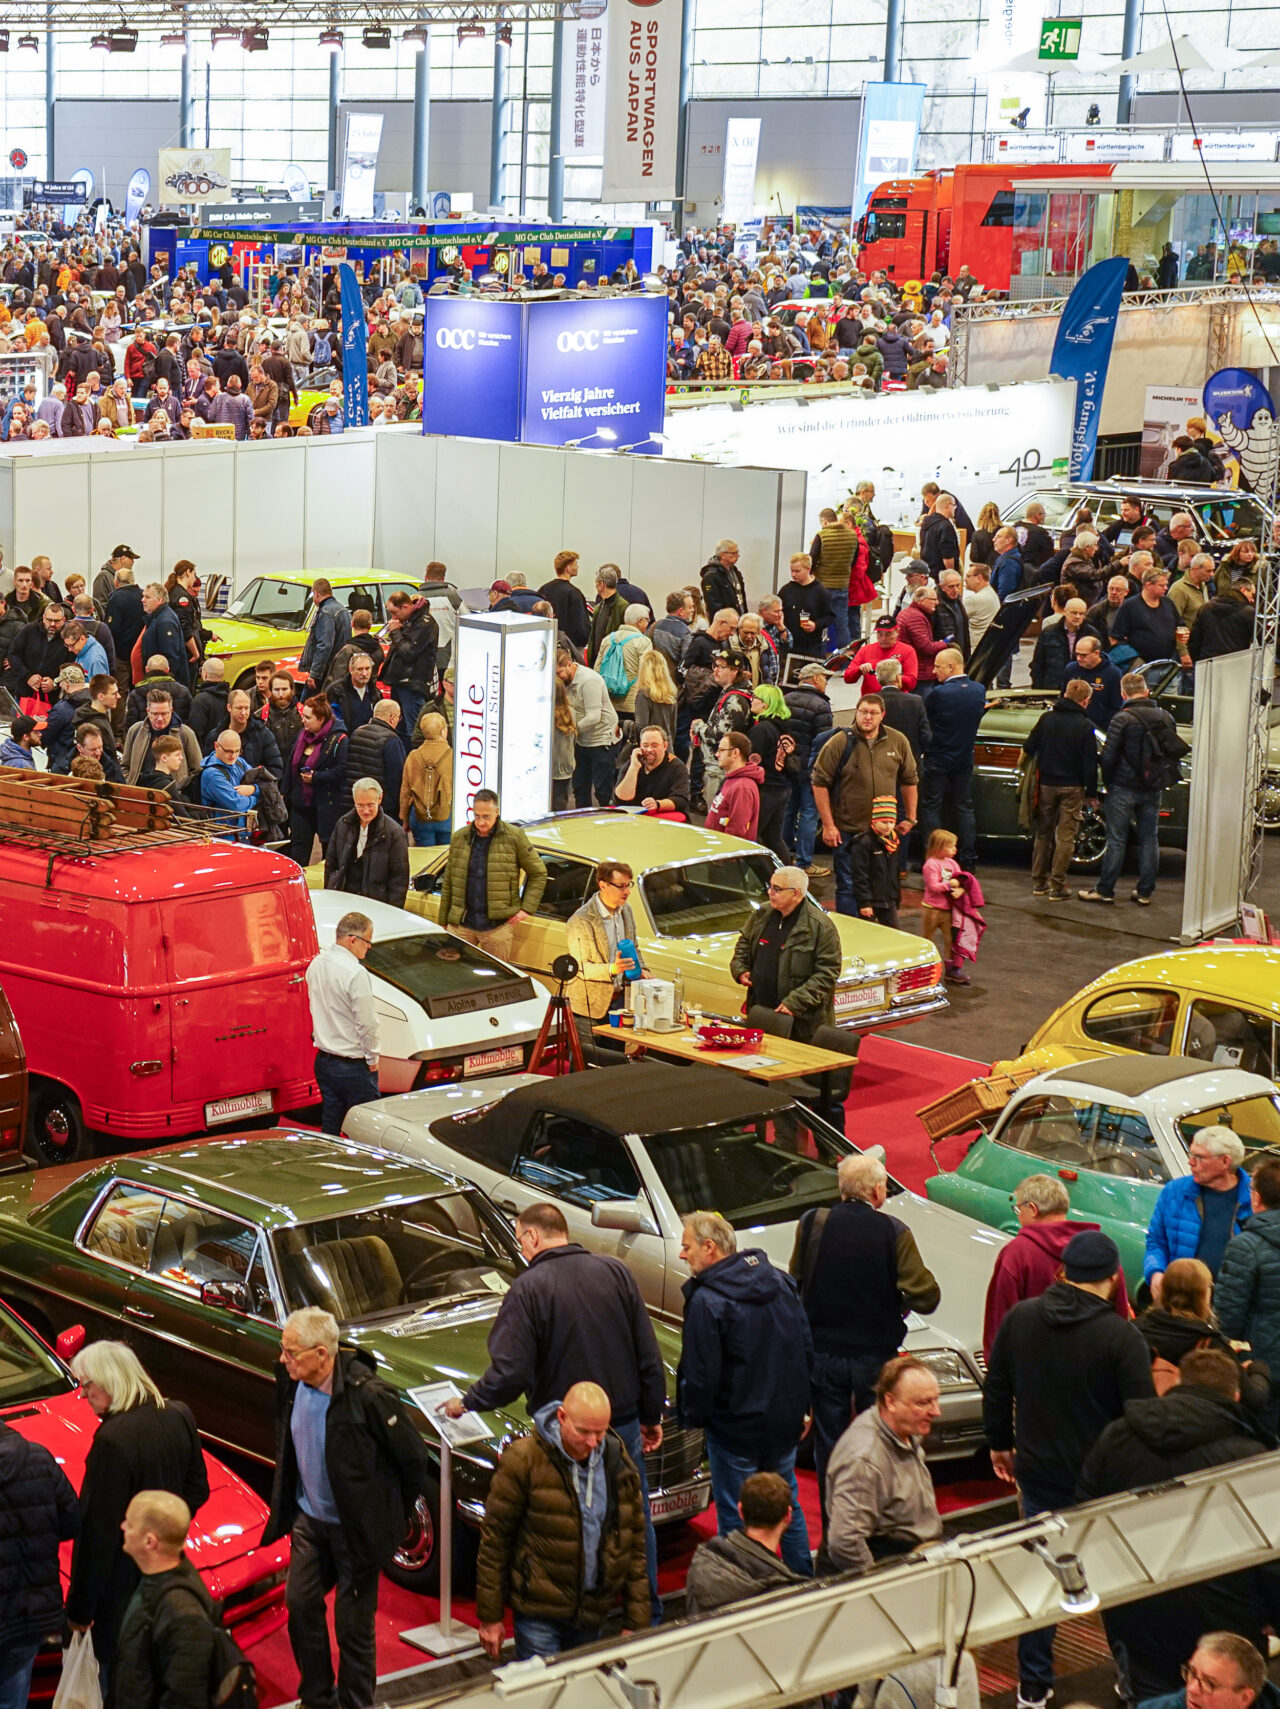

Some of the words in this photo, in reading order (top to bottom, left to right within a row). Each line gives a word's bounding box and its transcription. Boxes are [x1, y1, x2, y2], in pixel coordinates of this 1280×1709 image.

[629, 20, 642, 65] AUS
[590, 28, 602, 86] 日本から
[626, 71, 640, 142] JAPAN
[642, 20, 658, 177] SPORTWAGEN
[1096, 142, 1144, 152] württembergische
[1204, 141, 1255, 152] württembergische
[203, 230, 212, 238] MG
[224, 232, 236, 240] Club
[306, 236, 316, 244] MG
[328, 237, 341, 246] Club
[342, 238, 376, 247] Deutschland
[388, 237, 400, 247] MG
[400, 238, 414, 246] Car
[414, 236, 430, 246] Club
[431, 235, 470, 246] Deutschland
[514, 232, 527, 242] MG
[528, 232, 541, 242] Car
[541, 232, 554, 241] Club
[556, 230, 590, 240] Deutschland
[436, 328, 476, 350] OCC
[556, 329, 600, 352] OCC
[541, 389, 582, 404] Vierzig
[583, 386, 615, 402] Jahre
[541, 405, 583, 421] Vielfalt
[584, 401, 640, 417] versichert
[777, 423, 796, 434] Wir
[798, 421, 820, 432] sind
[822, 418, 838, 430] die
[840, 416, 881, 430] Erfinder
[882, 415, 900, 426] der
[902, 406, 1012, 424] Oldtimerversicherung.
[1070, 401, 1096, 478] Wolfsburg
[1084, 370, 1098, 397] e.V.
[490, 665, 500, 714] Stern
[490, 722, 498, 750] mit
[447, 998, 476, 1013] Alpine
[486, 988, 522, 1005] Renault
[833, 988, 877, 1006] Kultmobile
[468, 1047, 516, 1068] Kultmobile
[210, 1096, 262, 1117] Kultmobile
